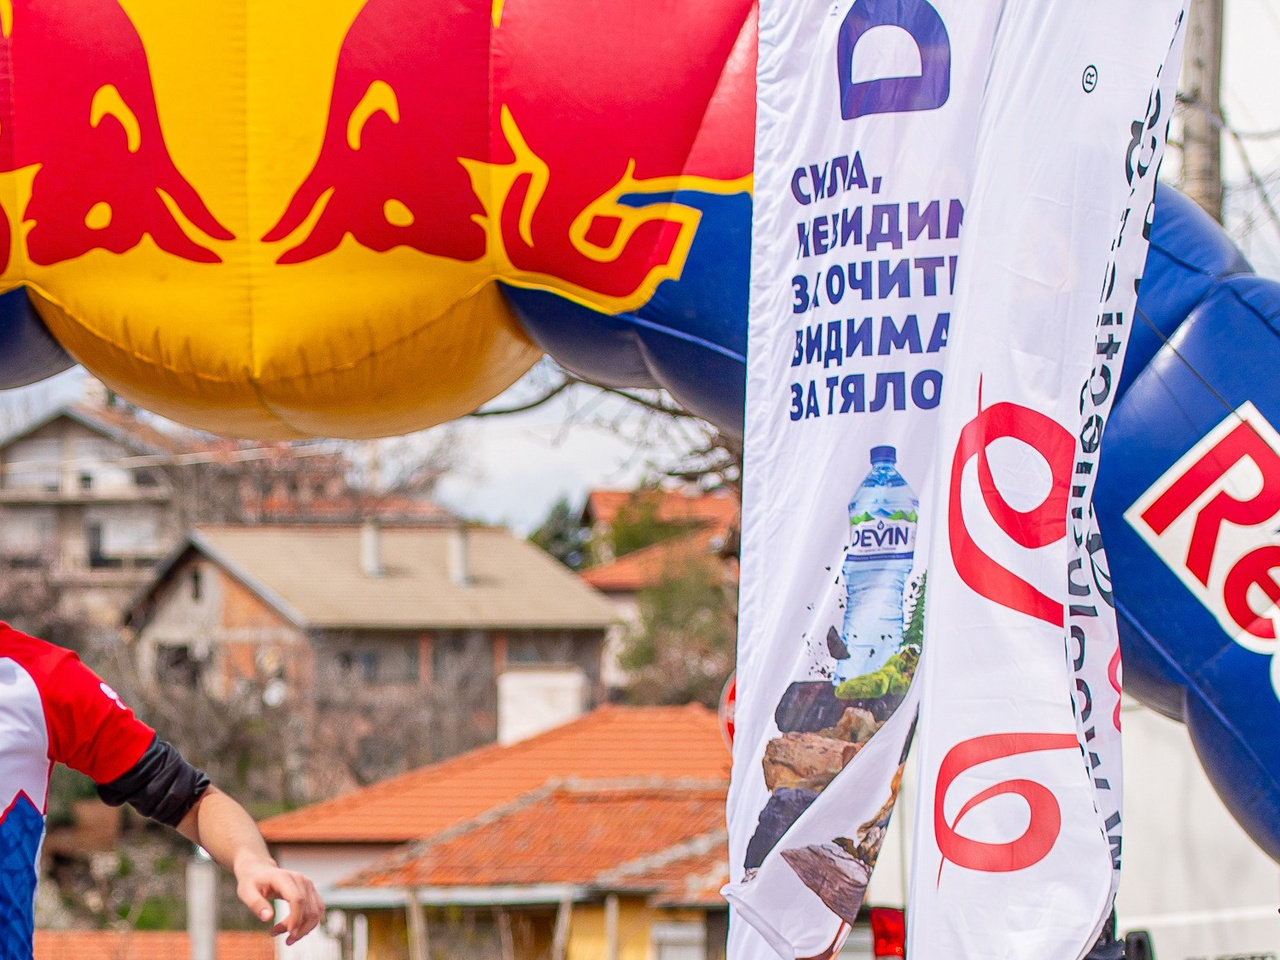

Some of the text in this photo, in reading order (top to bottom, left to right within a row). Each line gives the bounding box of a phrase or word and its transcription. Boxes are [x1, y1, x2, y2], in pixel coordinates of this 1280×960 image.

[791, 150, 882, 206] СИЛА,
[825, 255, 958, 305] ОЧИТ
[825, 369, 944, 415] ТЯЛО
